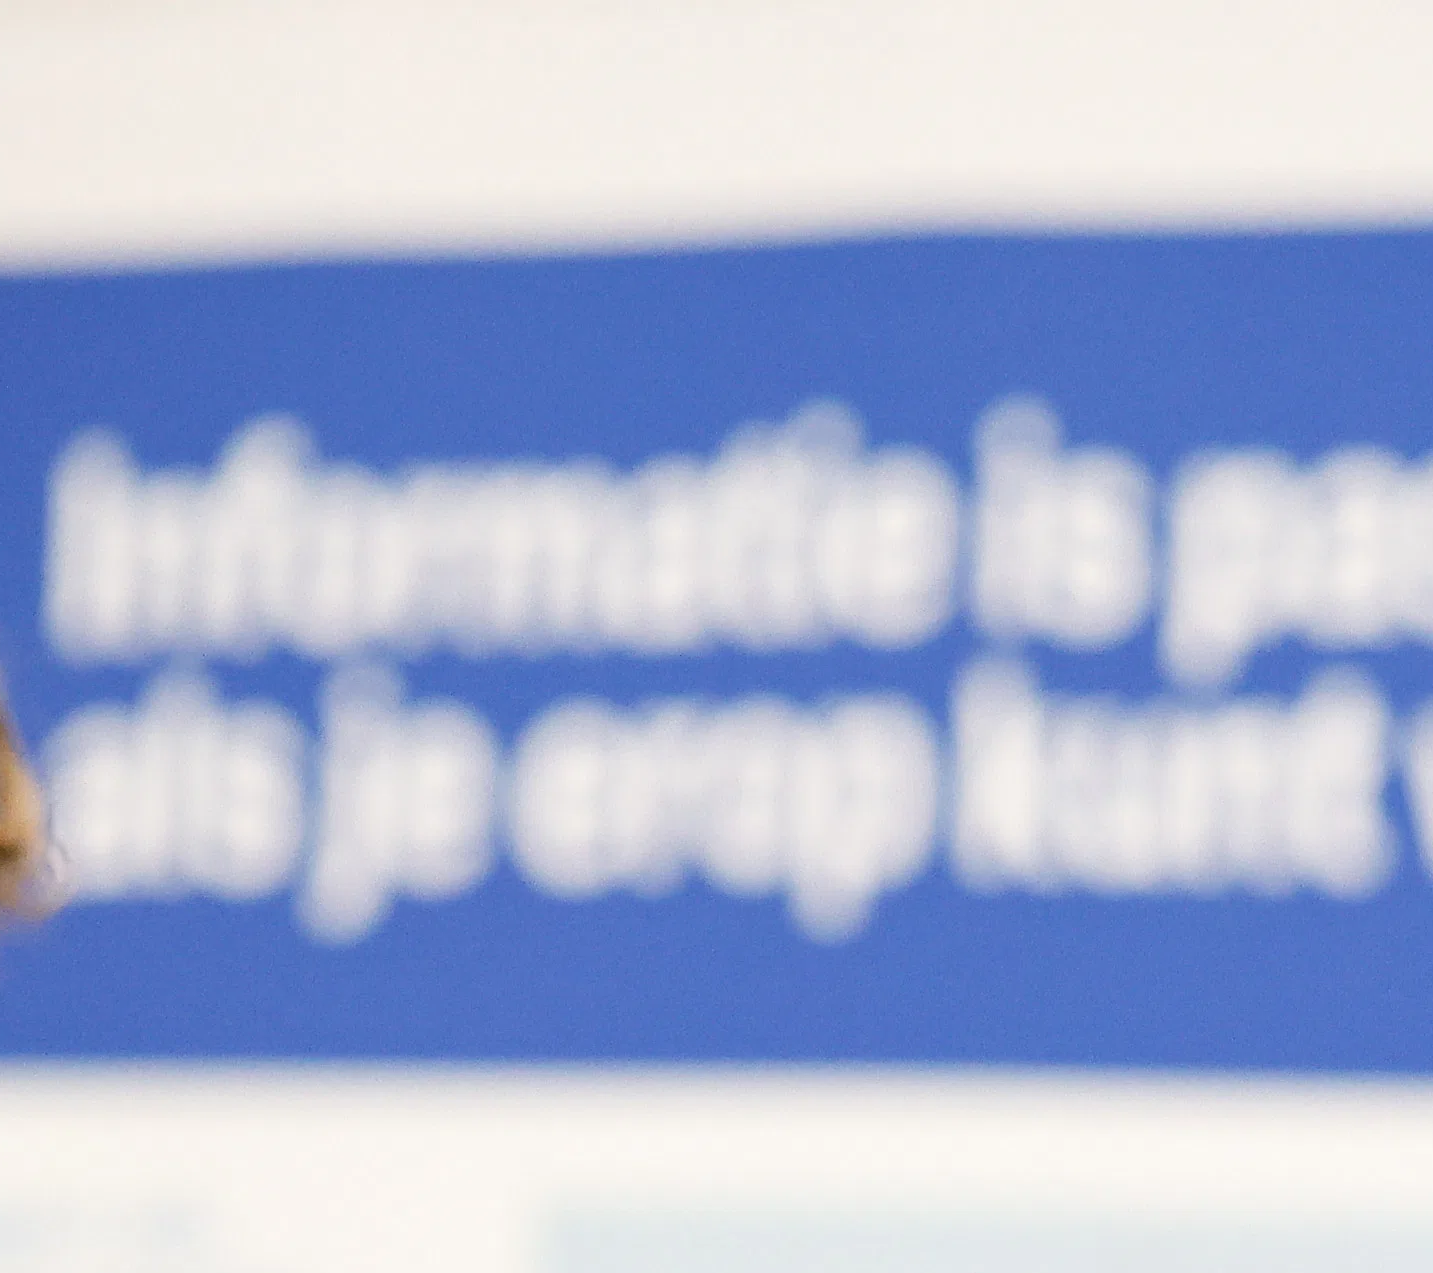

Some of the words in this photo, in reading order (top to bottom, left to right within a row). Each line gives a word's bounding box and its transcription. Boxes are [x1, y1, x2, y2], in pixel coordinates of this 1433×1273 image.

[48, 400, 960, 660] Informatie
[973, 397, 1156, 650] is
[45, 664, 305, 898] als
[299, 660, 496, 940] je
[512, 694, 940, 939] erop
[952, 655, 1392, 895] kunt
